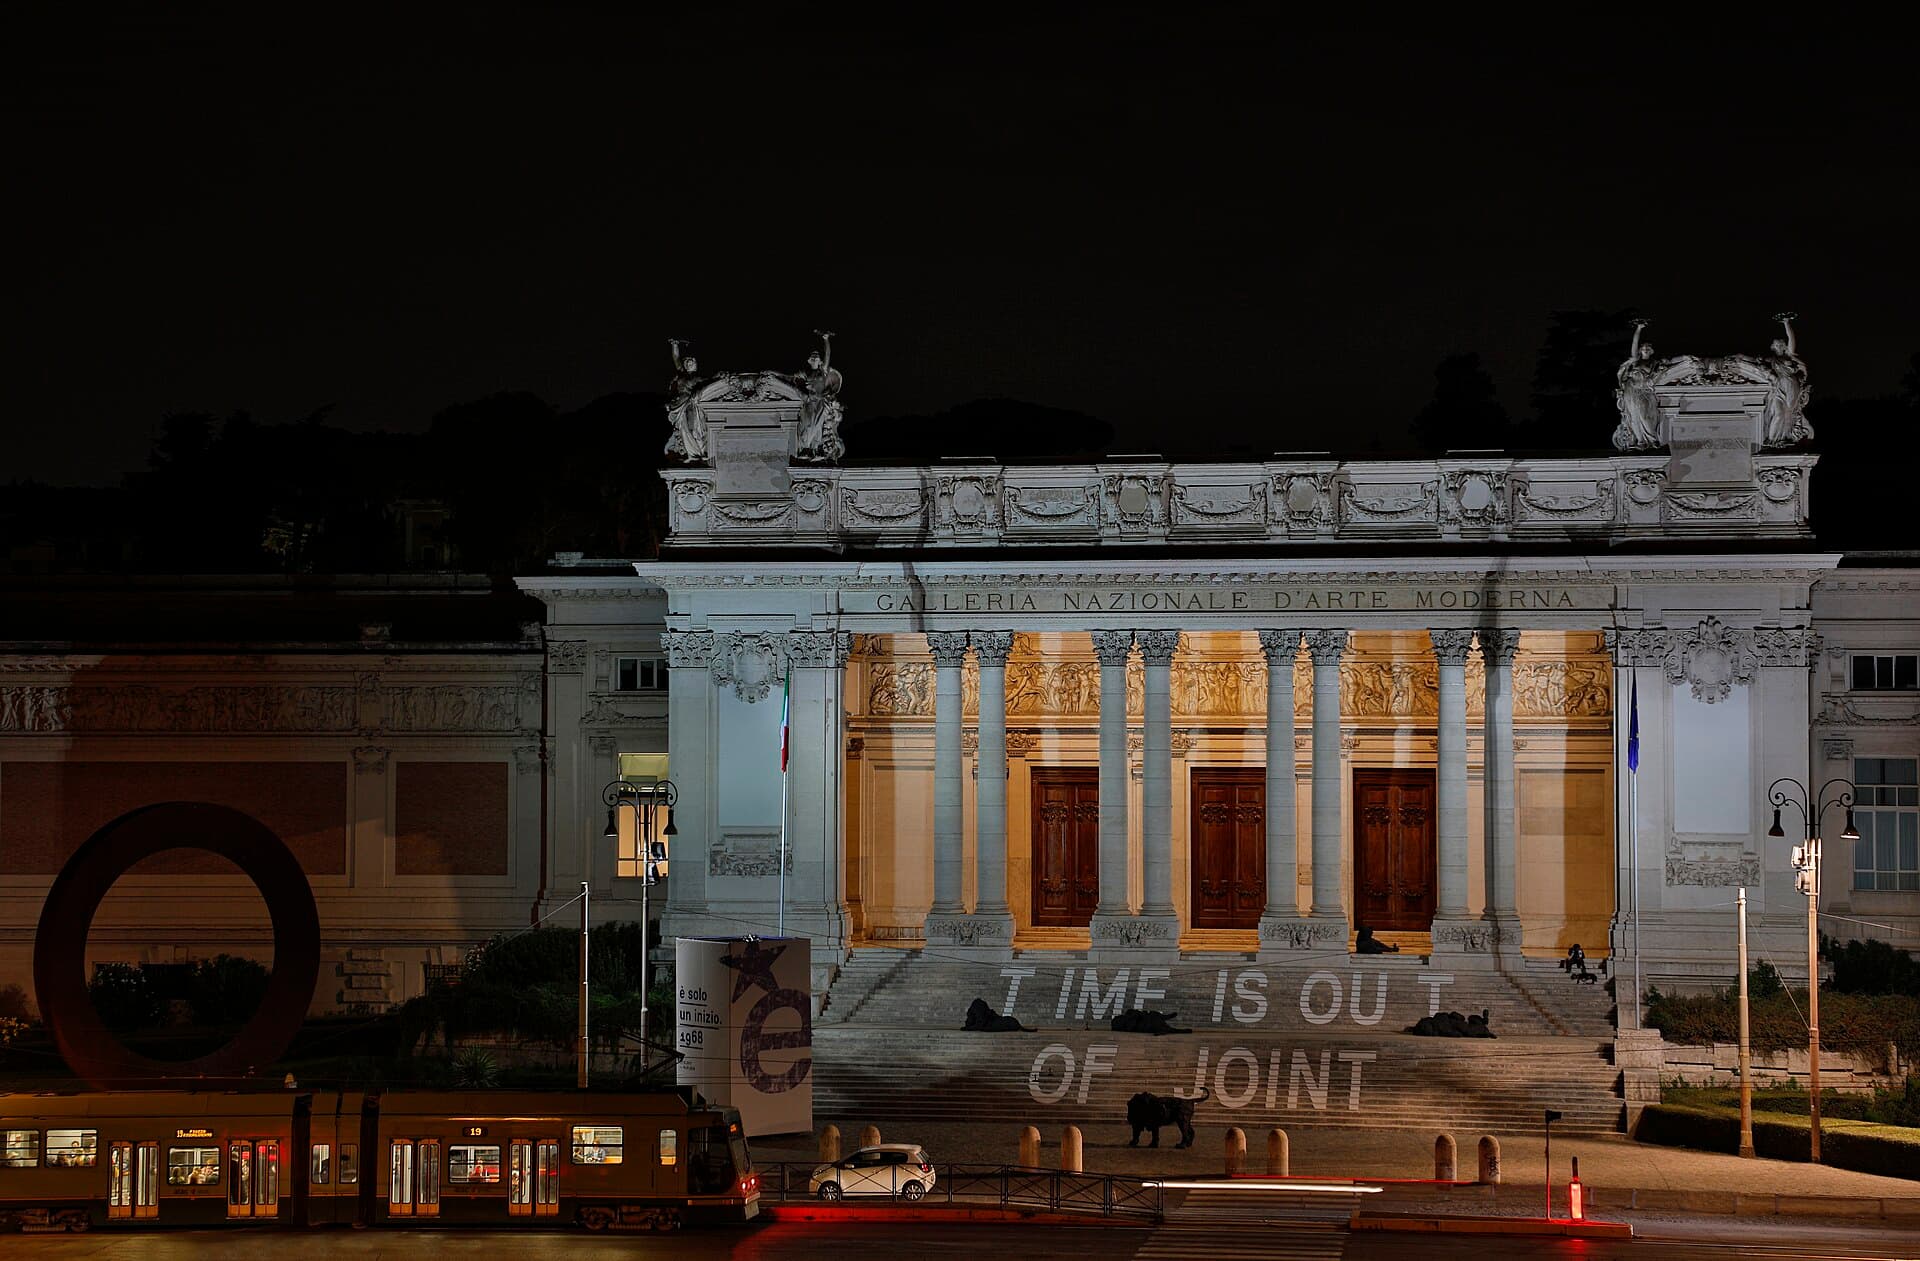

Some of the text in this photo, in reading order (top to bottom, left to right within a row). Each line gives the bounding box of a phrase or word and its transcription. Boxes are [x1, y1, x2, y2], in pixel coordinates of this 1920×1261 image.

[876, 589, 1577, 612] GALLERIA NAZIONALE D'ARTE MODERNA
[688, 987, 707, 1001] solo
[1211, 969, 1269, 1024] IS
[680, 1008, 722, 1025] un inizio.
[680, 1030, 703, 1046] 1968
[1028, 1043, 1377, 1112] OF JOINT
[470, 1127, 482, 1136] 19
